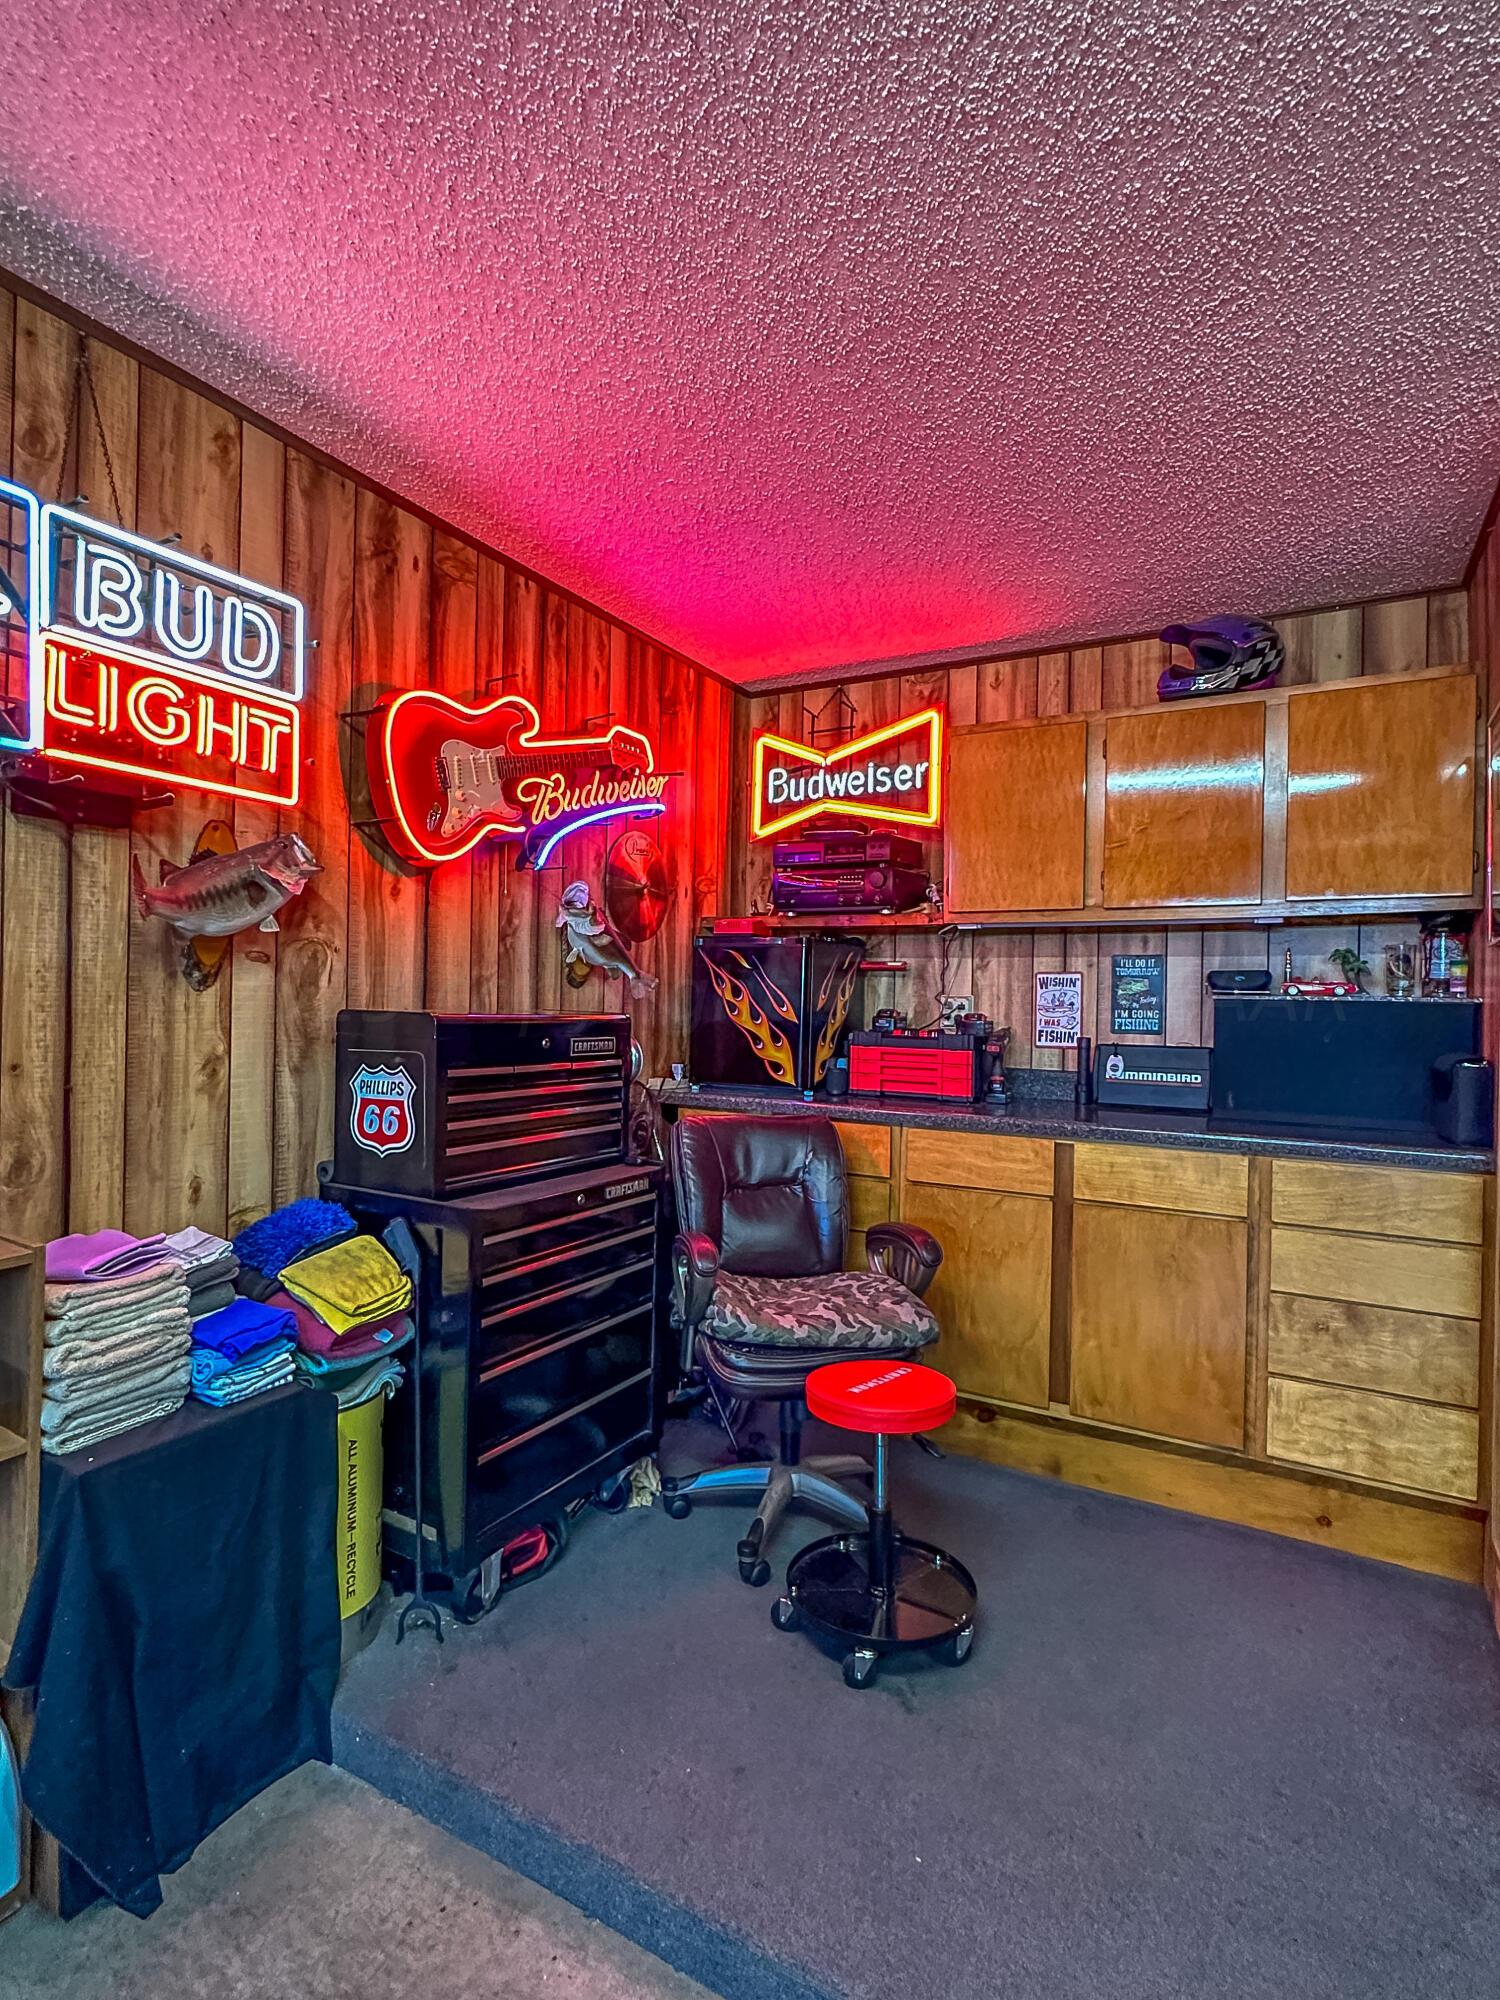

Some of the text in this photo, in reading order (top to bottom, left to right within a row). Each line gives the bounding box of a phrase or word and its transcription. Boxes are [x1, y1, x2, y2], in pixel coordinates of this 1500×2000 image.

[75, 536, 281, 681] BUD
[45, 643, 292, 774] LIGHT
[767, 762, 929, 805] Budweiser
[516, 769, 669, 825] Budweiser
[1120, 958, 1156, 968] I'LL DO IT
[1115, 967, 1160, 976] TOMORROW
[1038, 976, 1080, 990] WISHIN'
[1114, 1009, 1160, 1019] I'M GOING
[1044, 1018, 1061, 1027] WAS
[1114, 1018, 1159, 1031] FISHING
[1037, 1029, 1078, 1044] FISHIN'
[574, 1040, 614, 1052] CRAFTSMAN
[359, 1079, 405, 1097] PHILLIPS
[363, 1104, 401, 1136] 66
[605, 1177, 649, 1200] CRAFTSMAN
[348, 1439, 358, 1461] ALL
